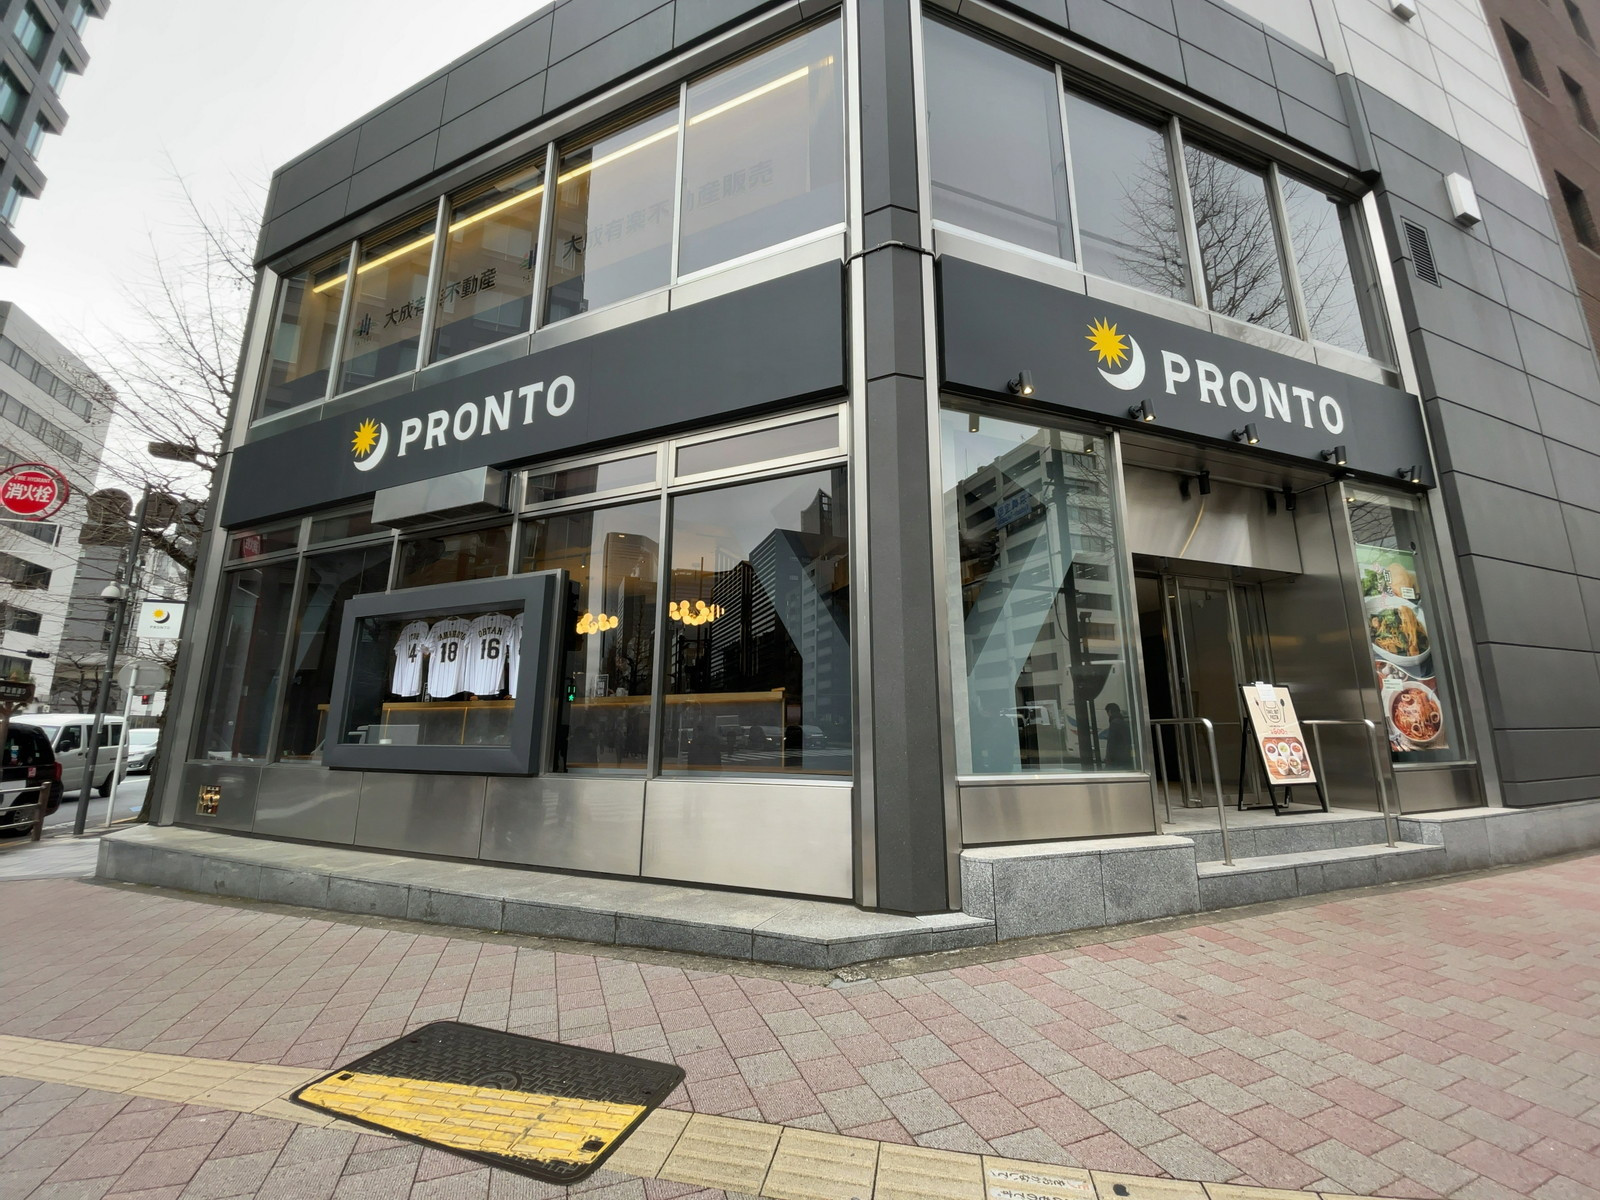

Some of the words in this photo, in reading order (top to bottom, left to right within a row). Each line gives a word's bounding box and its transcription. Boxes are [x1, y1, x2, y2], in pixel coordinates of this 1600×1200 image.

[384, 267, 497, 328] 大成有不動産
[1160, 349, 1345, 436] PRONTO
[397, 374, 576, 458] PRONTO
[4, 482, 53, 503] 消火栓
[440, 641, 459, 662] 18
[480, 638, 500, 660] 16
